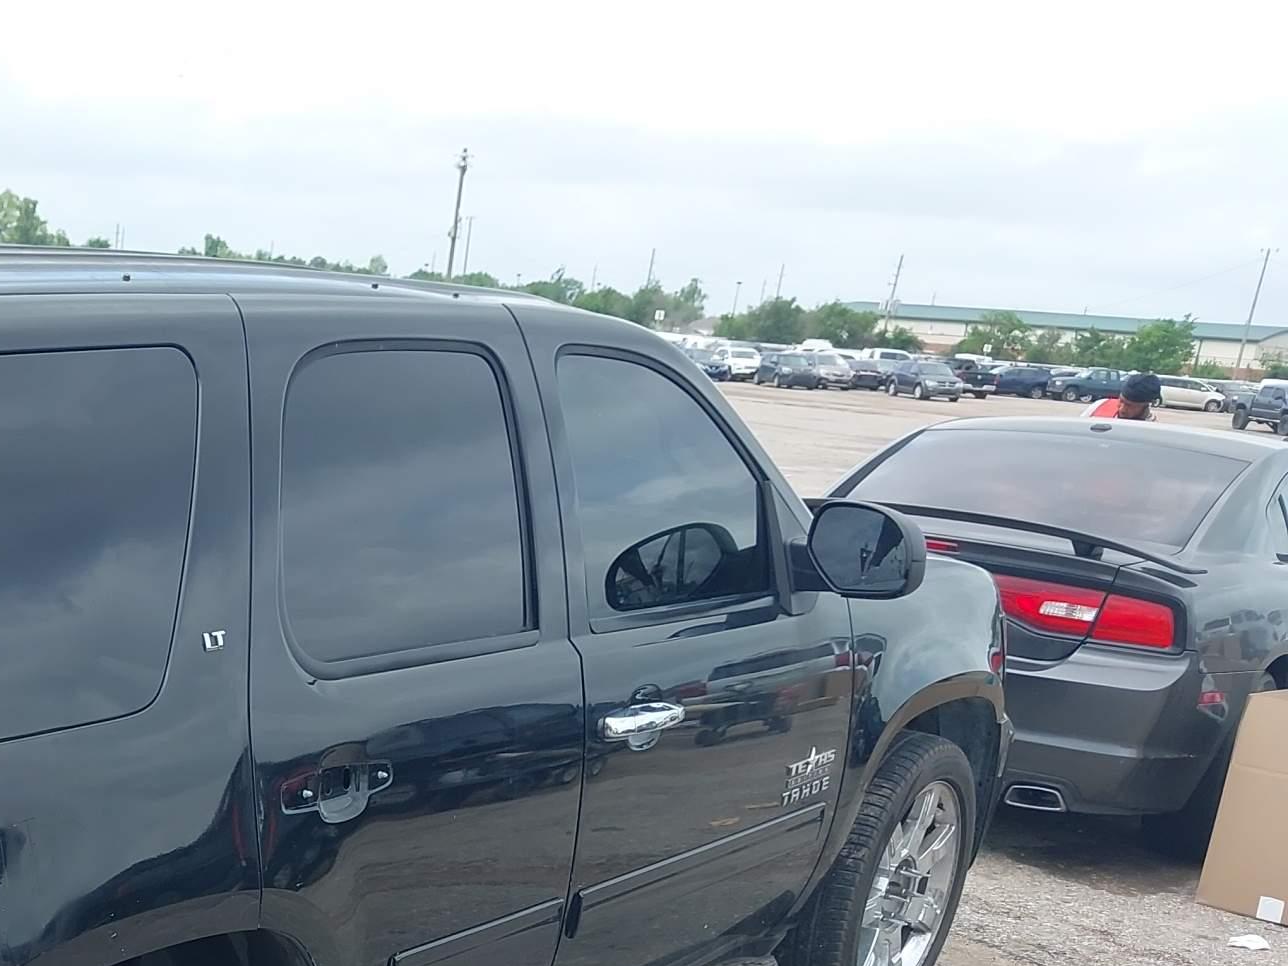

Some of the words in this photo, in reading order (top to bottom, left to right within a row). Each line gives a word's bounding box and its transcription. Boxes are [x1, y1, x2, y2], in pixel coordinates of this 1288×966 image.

[202, 630, 226, 652] LT
[787, 746, 837, 777] TEXAS
[782, 776, 830, 807] TAHOE
